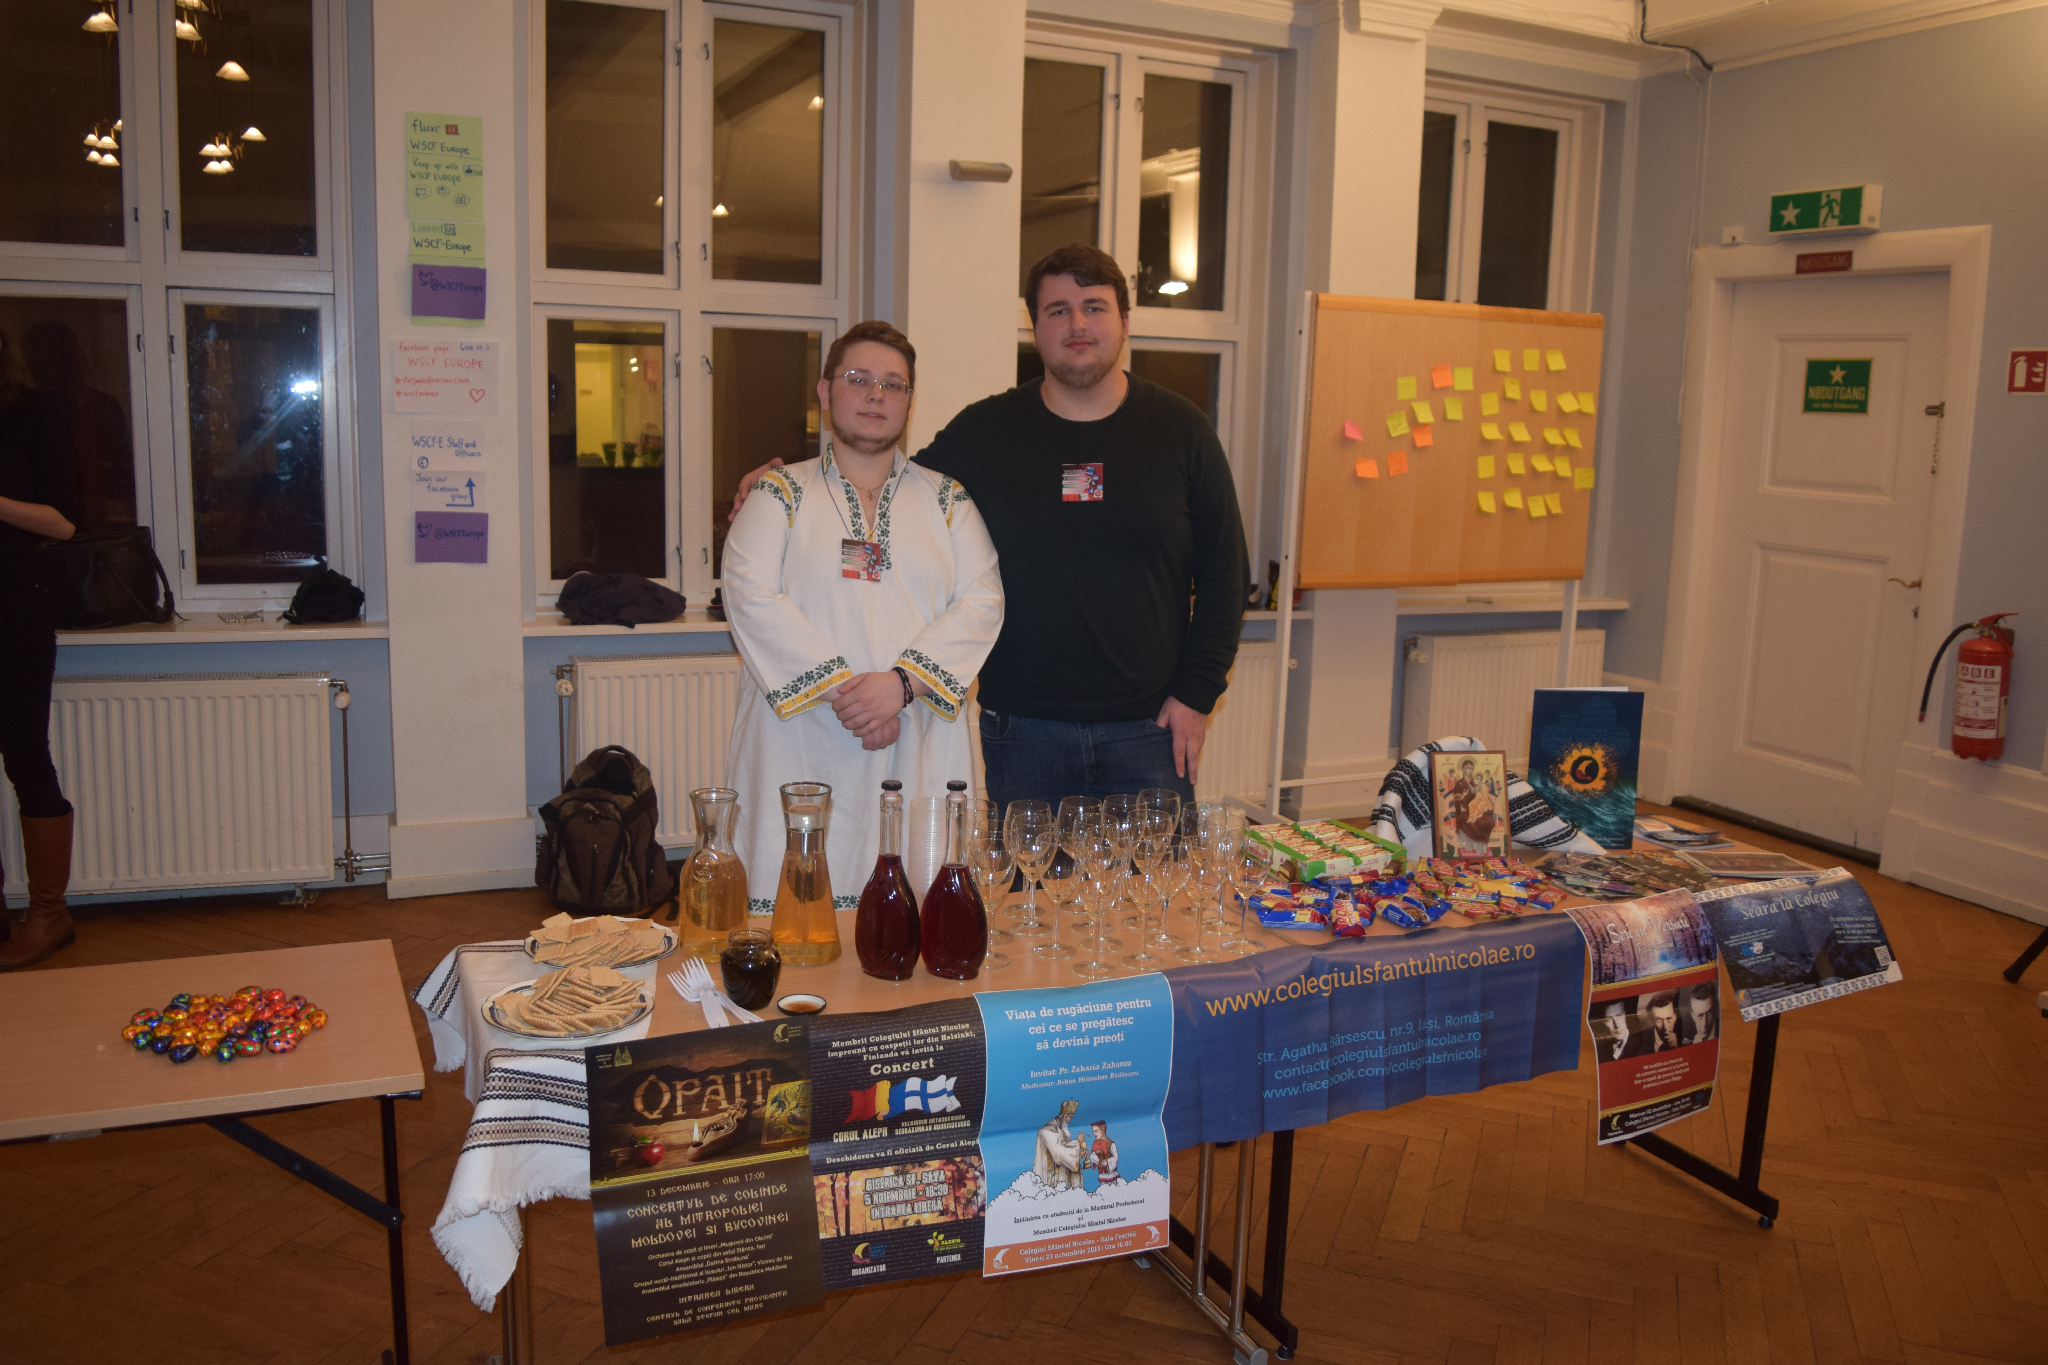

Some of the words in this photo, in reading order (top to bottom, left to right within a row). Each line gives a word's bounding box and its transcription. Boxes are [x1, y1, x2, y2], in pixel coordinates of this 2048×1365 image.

[411, 140, 437, 150] WSCF
[413, 157, 429, 170] Keep
[446, 161, 458, 170] with
[408, 357, 436, 366] WSCF
[444, 358, 483, 369] EUROPE
[1808, 386, 1866, 400] NØDUTGANG
[447, 437, 464, 448] Staff
[465, 440, 476, 448] and
[416, 474, 432, 482] Join
[1741, 902, 1779, 920] Seara
[1780, 896, 1793, 910] la
[1795, 888, 1839, 908] Colegiu
[1607, 922, 1633, 945] Seri
[1646, 912, 1690, 934] Versuri
[1205, 941, 1536, 1016] www.colegiulsfantulnicolae.ro
[1005, 1009, 1036, 1022] Viața
[1040, 1006, 1054, 1017] de
[1057, 1000, 1113, 1016] rugăciune
[1116, 999, 1152, 1012] pentru
[1029, 1024, 1045, 1034] cei
[1049, 1023, 1062, 1032] ce
[1065, 1021, 1077, 1030] se
[1081, 1015, 1134, 1031] pregătesc
[832, 1037, 867, 1048] Membrii
[870, 1031, 910, 1042] Colegiului
[913, 1027, 939, 1036] Sfântul
[941, 1023, 970, 1033] Nicolae
[941, 1031, 976, 1041] Helsinki,
[1036, 1039, 1049, 1050] să
[1053, 1035, 1090, 1049] devină
[1093, 1031, 1125, 1047] preoți
[1257, 1051, 1276, 1065] Str.
[1281, 1042, 1327, 1061] Agatha
[1445, 1009, 1494, 1027] România
[863, 1051, 899, 1061] Finlanda
[870, 1057, 935, 1076] Concert
[1030, 1069, 1057, 1078] Invitat:
[1059, 1067, 1069, 1075] Pr.
[1071, 1063, 1100, 1072] Zaharia
[1102, 1061, 1131, 1069] Zaharou
[1021, 1081, 1055, 1090] Moderator:
[833, 1129, 860, 1143] CORUL
[862, 1127, 888, 1140] ALEPH
[826, 1153, 874, 1164] Deschiderea
[887, 1148, 893, 1156] fi
[936, 1141, 958, 1149] Corul
[646, 1188, 656, 1198] 13
[660, 1180, 710, 1196] DECEMBRIE
[723, 1176, 740, 1186] ORA
[745, 1171, 765, 1182] 17:00
[865, 1175, 904, 1192] BISERICA
[906, 1172, 921, 1187] SF.
[922, 1169, 946, 1183] SAVA
[711, 1193, 727, 1205] DE
[735, 1183, 788, 1201] COLINDE
[864, 1193, 871, 1206] 5
[873, 1186, 917, 1204] NOIEMBRIE
[871, 1202, 913, 1220] INTRAREA
[1091, 1203, 1114, 1212] Masterul
[1116, 1198, 1144, 1207] Profesional
[655, 1217, 673, 1230] AL
[680, 1202, 763, 1225] MITROPOLIEI
[631, 1227, 697, 1249] MOLDOVEI
[725, 1212, 789, 1234] BUCOVINEI
[1033, 1228, 1057, 1236] Membrii
[1059, 1223, 1086, 1231] Colegiului
[1107, 1216, 1126, 1224] Nicolae
[1020, 1246, 1046, 1255] Colegiul
[1048, 1243, 1071, 1251] Sfântul
[1072, 1239, 1095, 1247] Nicolae
[1115, 1231, 1136, 1239] Festivă
[1055, 1249, 1086, 1259] octombrie
